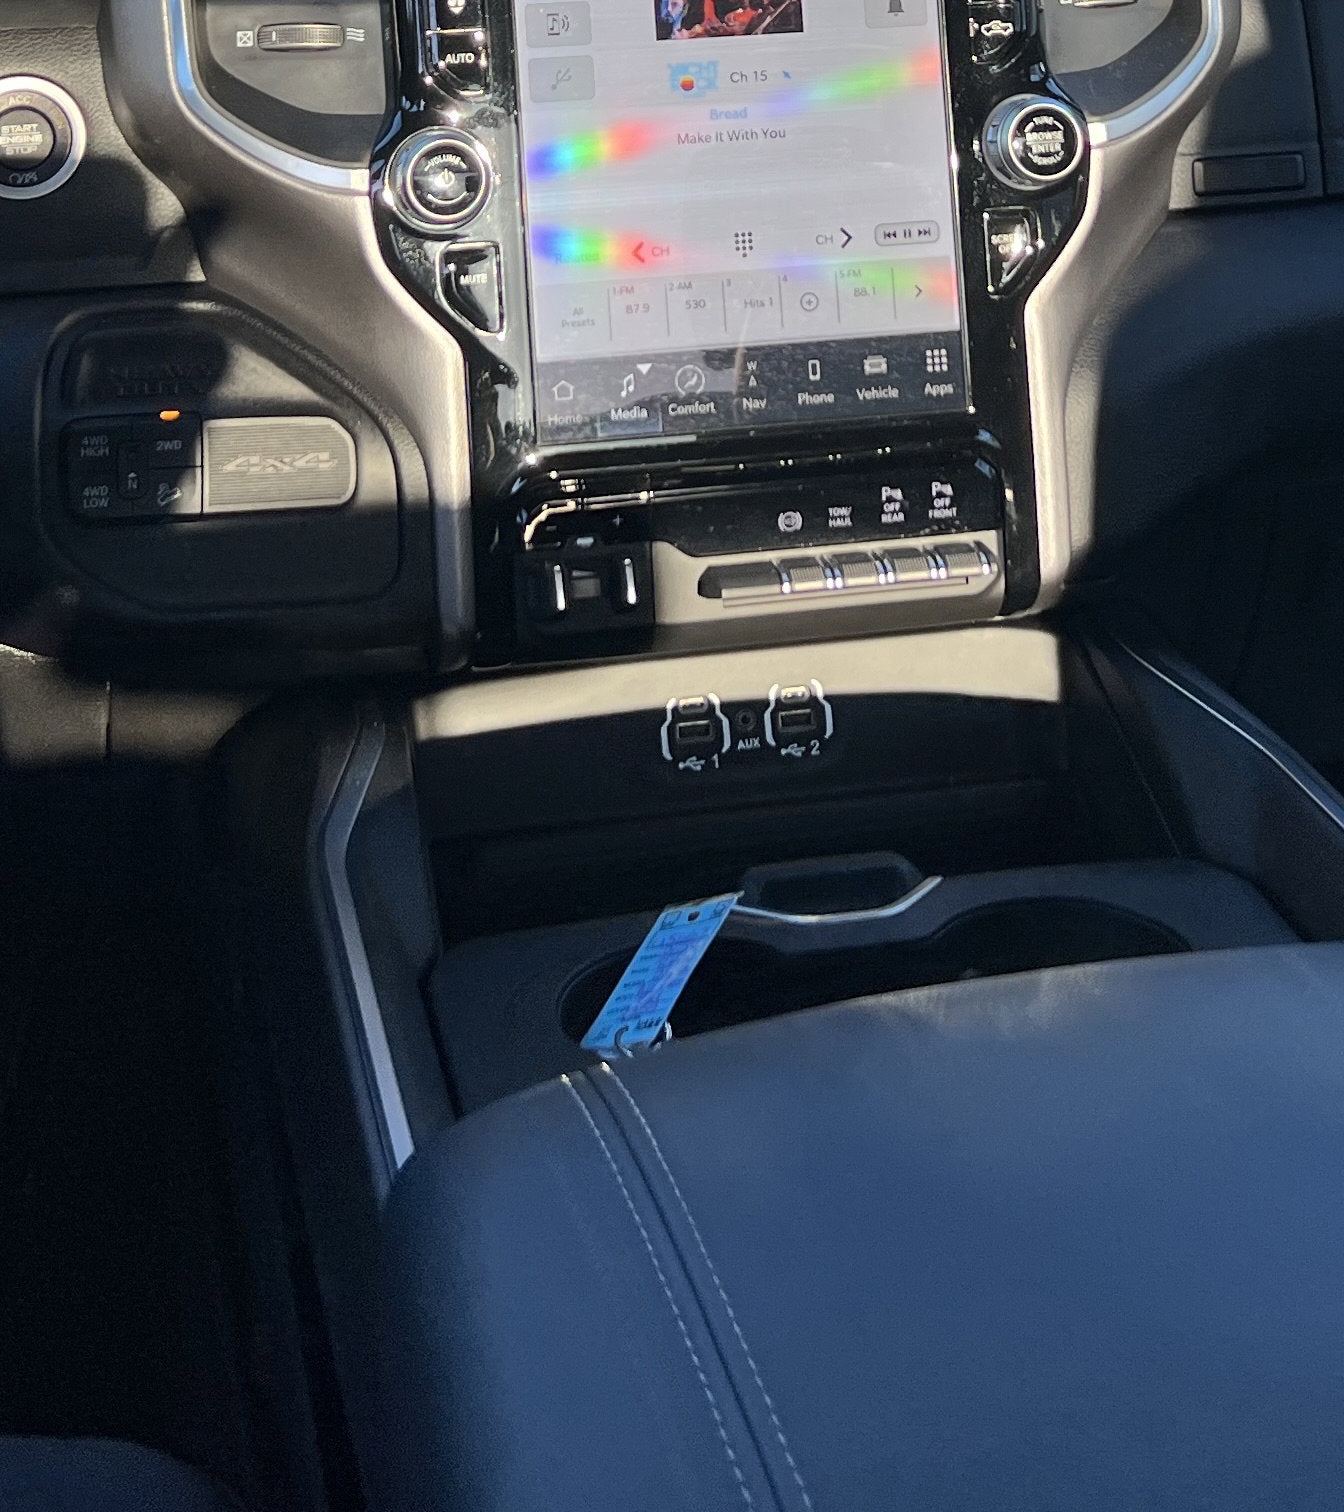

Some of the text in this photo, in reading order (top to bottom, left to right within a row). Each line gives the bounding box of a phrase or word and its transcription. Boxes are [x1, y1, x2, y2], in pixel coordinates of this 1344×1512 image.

[445, 53, 475, 64] AUTO
[729, 70, 768, 83] Ch 15
[9, 95, 32, 105] ACC
[710, 107, 748, 120] Bread
[1, 124, 38, 134] START
[677, 127, 786, 145] Make It With You
[1025, 131, 1064, 141] BROWSE
[6, 146, 37, 156] STOP
[1030, 144, 1061, 153] ENTER
[430, 154, 462, 167] VOLUME
[815, 235, 833, 245] CH
[651, 247, 669, 257] CH
[459, 273, 488, 285] MUTE
[854, 286, 876, 297] 88.1
[685, 299, 706, 309] 530
[744, 298, 765, 308] Hits
[562, 318, 595, 328] Presets
[856, 385, 899, 400] Vehicle
[924, 383, 954, 397] Apps
[742, 397, 767, 410] Nav
[798, 392, 834, 405] Phone
[610, 406, 648, 420] Media
[668, 401, 716, 416] Comfort
[548, 415, 583, 426] Home
[82, 436, 108, 446] 4WD
[156, 440, 182, 451] 2WD
[80, 446, 109, 457] HIGH
[220, 452, 338, 473] 4x4
[128, 479, 137, 490] N
[82, 486, 108, 497] 4WD
[83, 497, 110, 508] LOW
[883, 502, 900, 512] OFF
[934, 497, 951, 508] OFF
[881, 512, 904, 523] REAR
[928, 507, 957, 519] FRONT
[828, 517, 852, 528] HAUL
[737, 737, 761, 751] AUX
[810, 739, 820, 755] 2
[711, 753, 719, 768] 1
